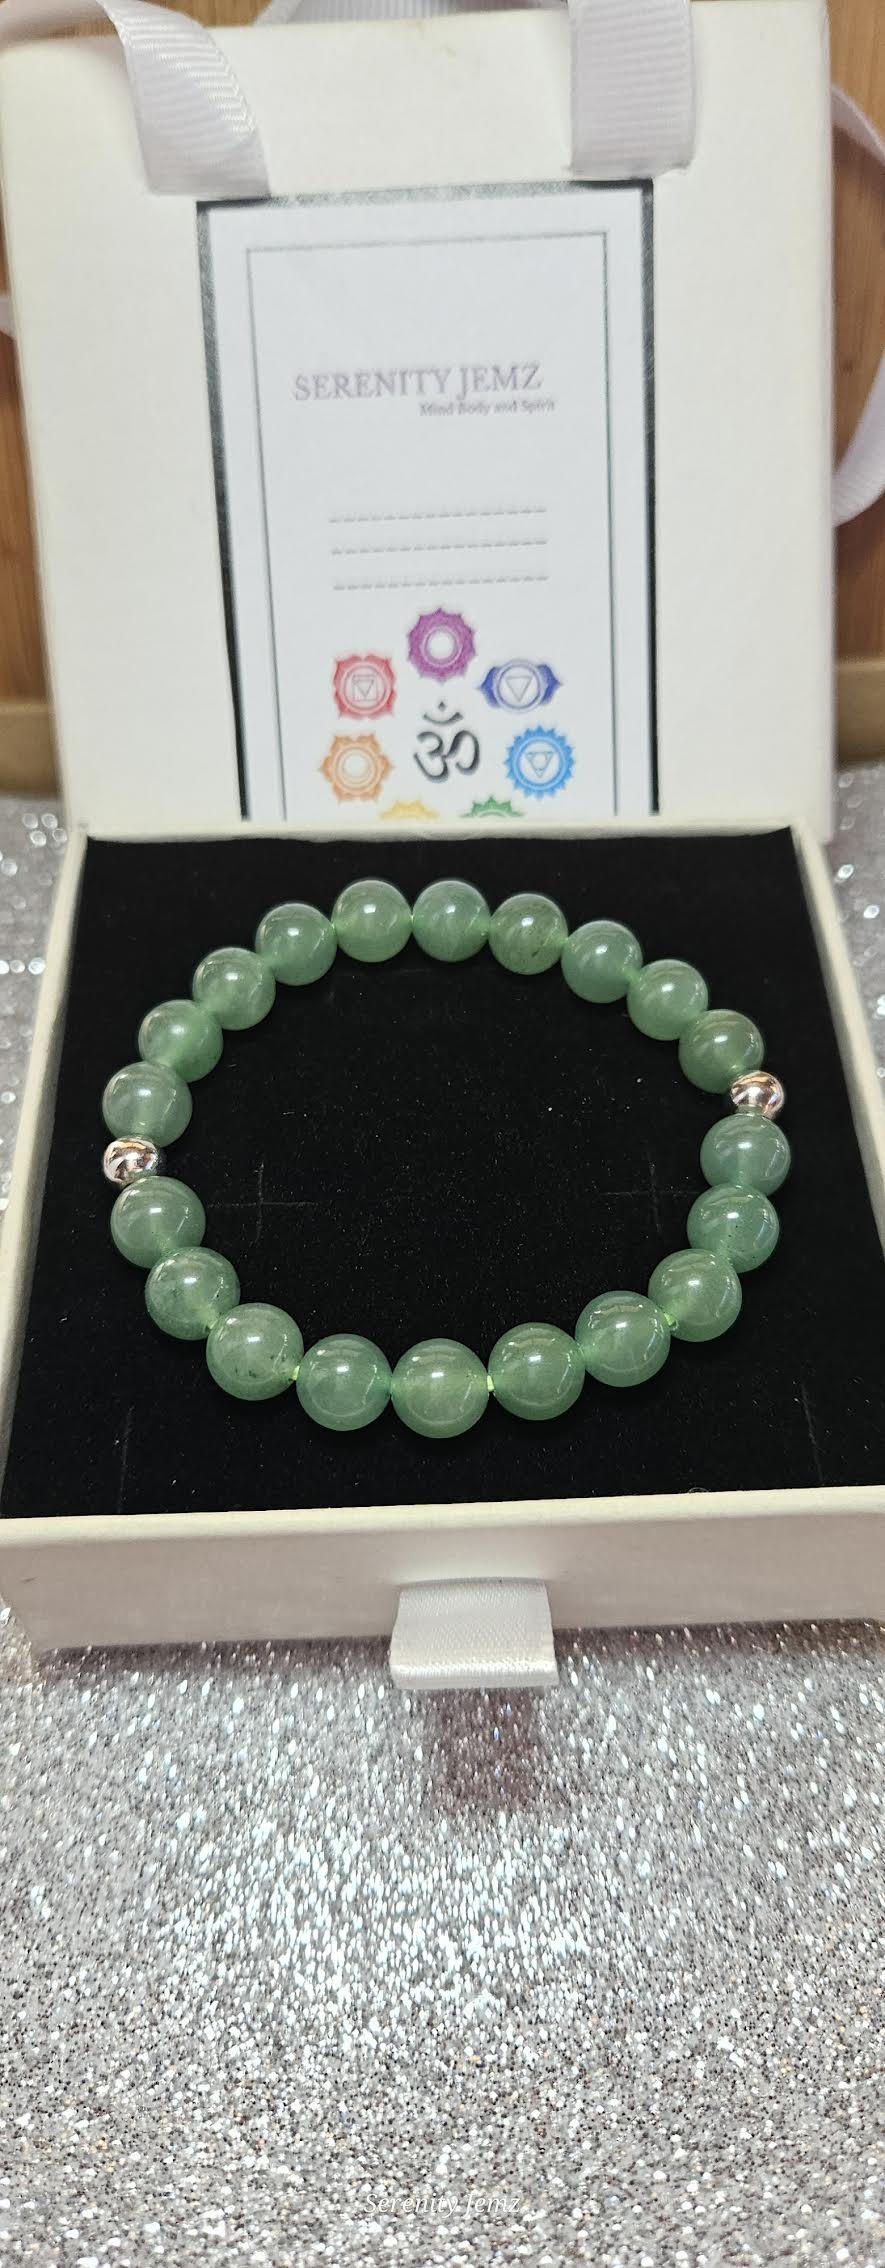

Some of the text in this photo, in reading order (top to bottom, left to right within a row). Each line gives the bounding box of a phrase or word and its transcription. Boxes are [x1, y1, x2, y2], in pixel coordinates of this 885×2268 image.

[293, 361, 543, 401] SERENITY JEMZ
[419, 399, 556, 416] Mind Body and Spirit
